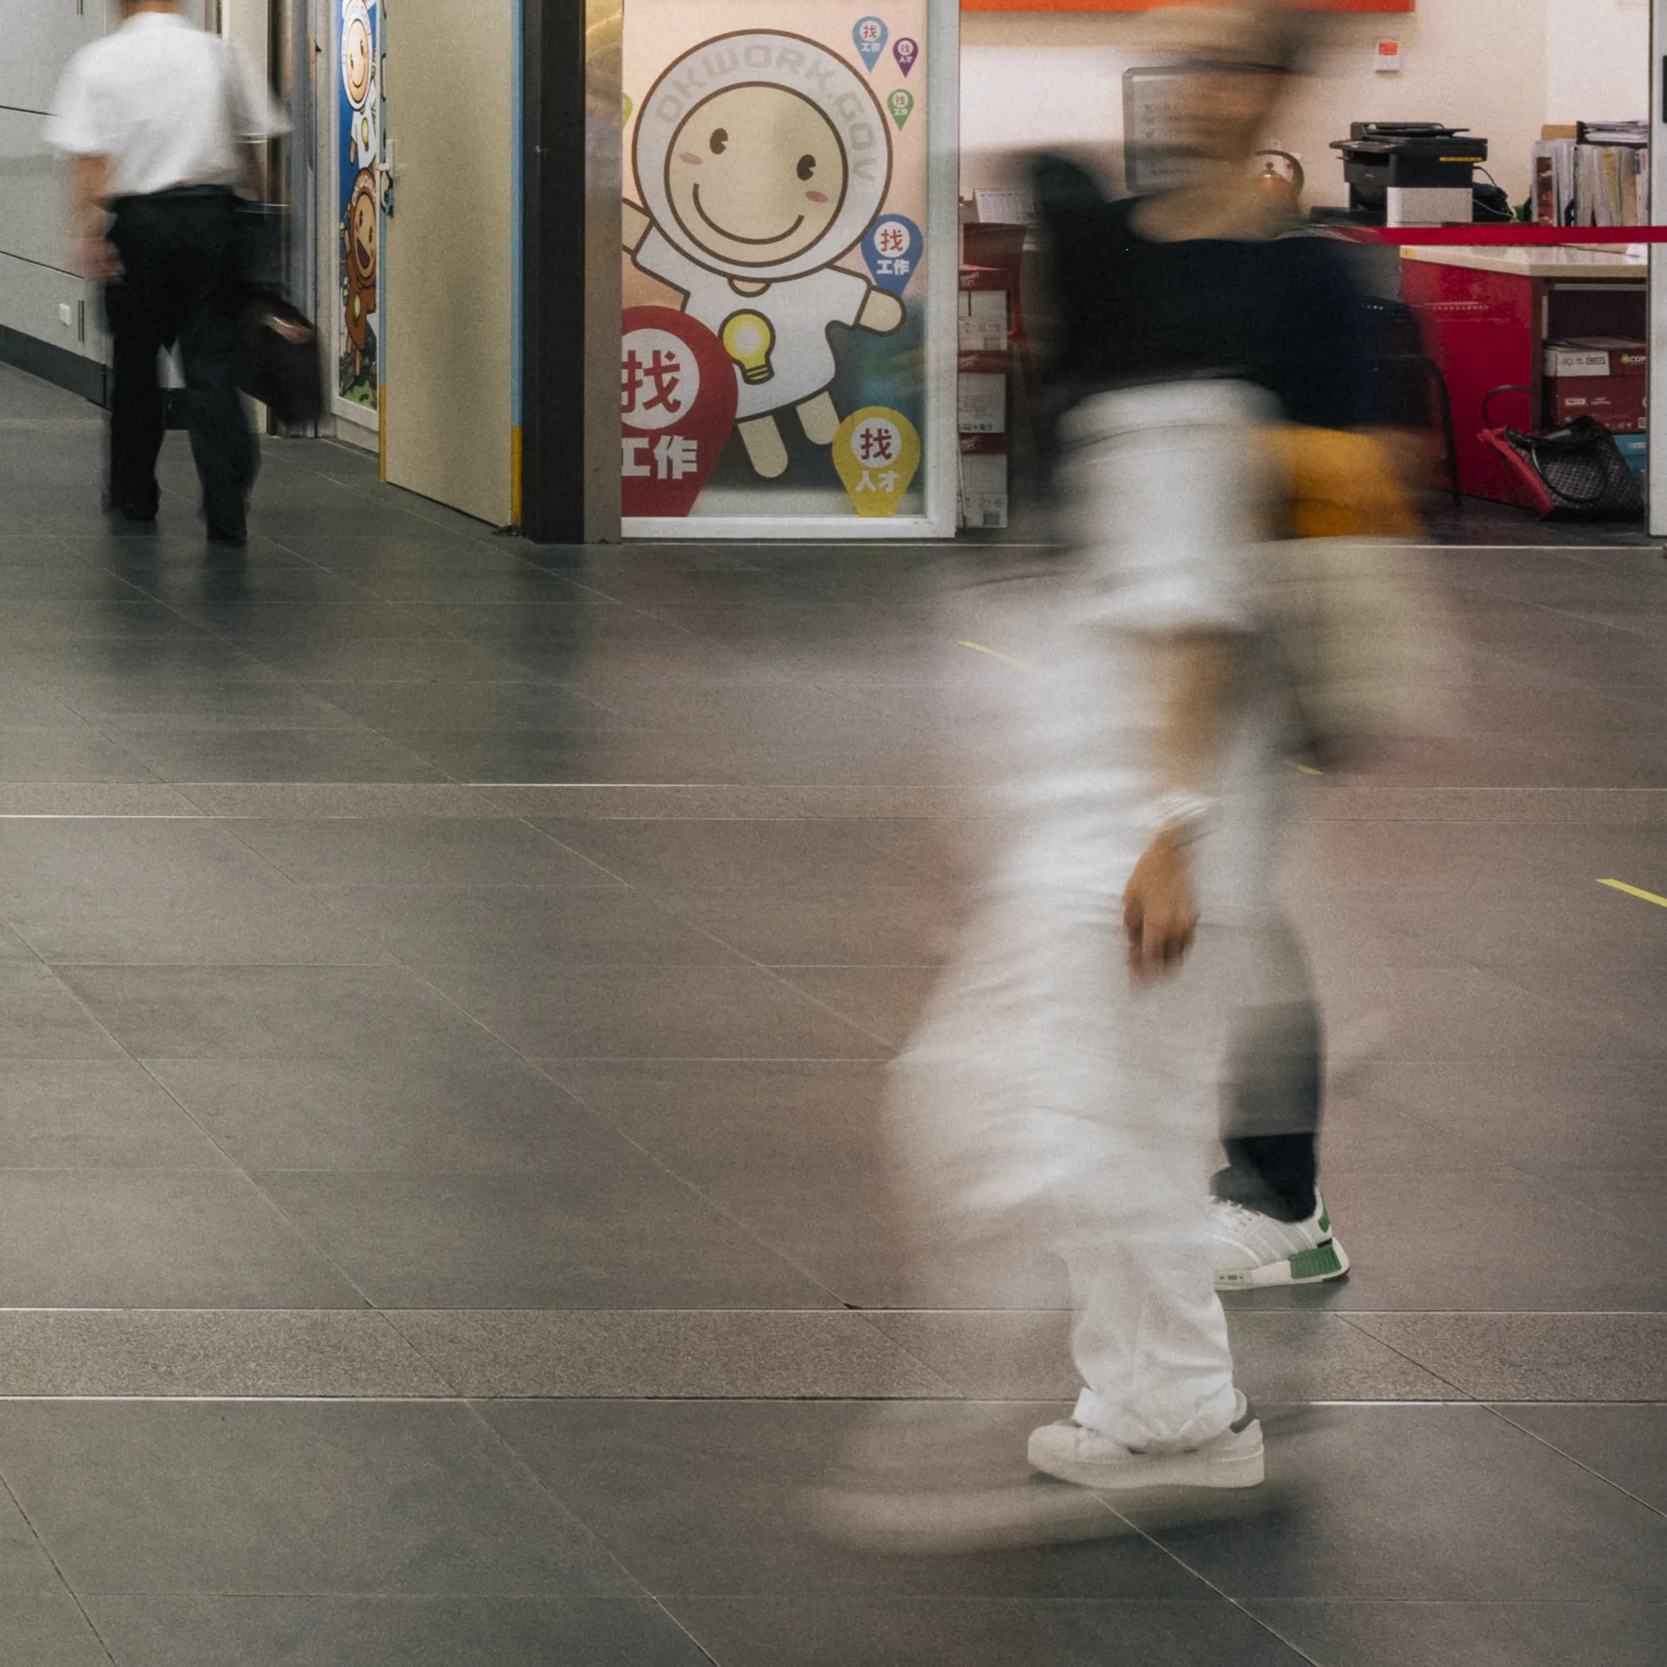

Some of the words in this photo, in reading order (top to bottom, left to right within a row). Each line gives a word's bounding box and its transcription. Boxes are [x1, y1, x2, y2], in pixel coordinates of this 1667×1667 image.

[879, 228, 905, 253] 找
[876, 259, 911, 276] 工作
[622, 348, 682, 414] 找
[622, 434, 698, 480] 工作
[860, 427, 893, 461] 找
[854, 470, 901, 494] 人才
